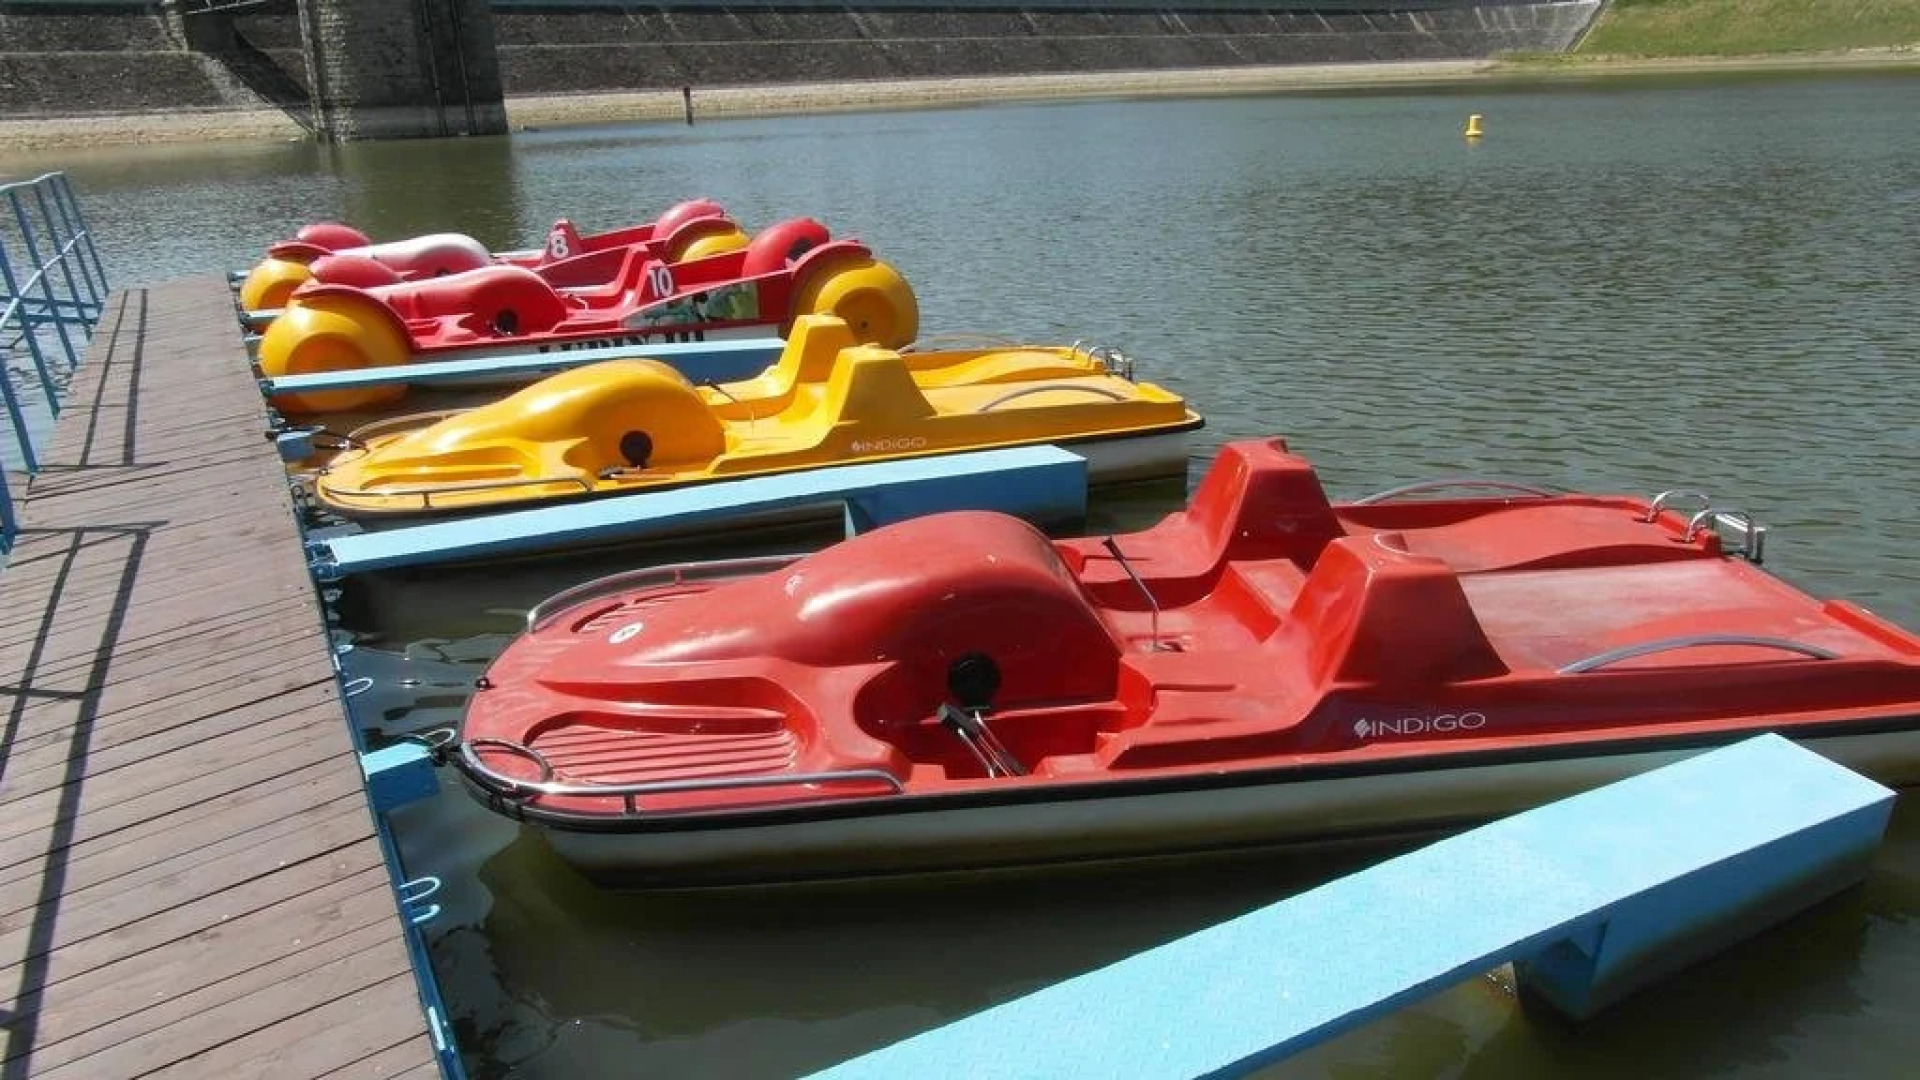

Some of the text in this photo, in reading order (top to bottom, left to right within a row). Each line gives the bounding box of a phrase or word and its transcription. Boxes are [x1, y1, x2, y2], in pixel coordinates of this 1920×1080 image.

[550, 234, 569, 258] 8
[649, 266, 674, 299] 10
[1371, 711, 1487, 737] INDiGO
